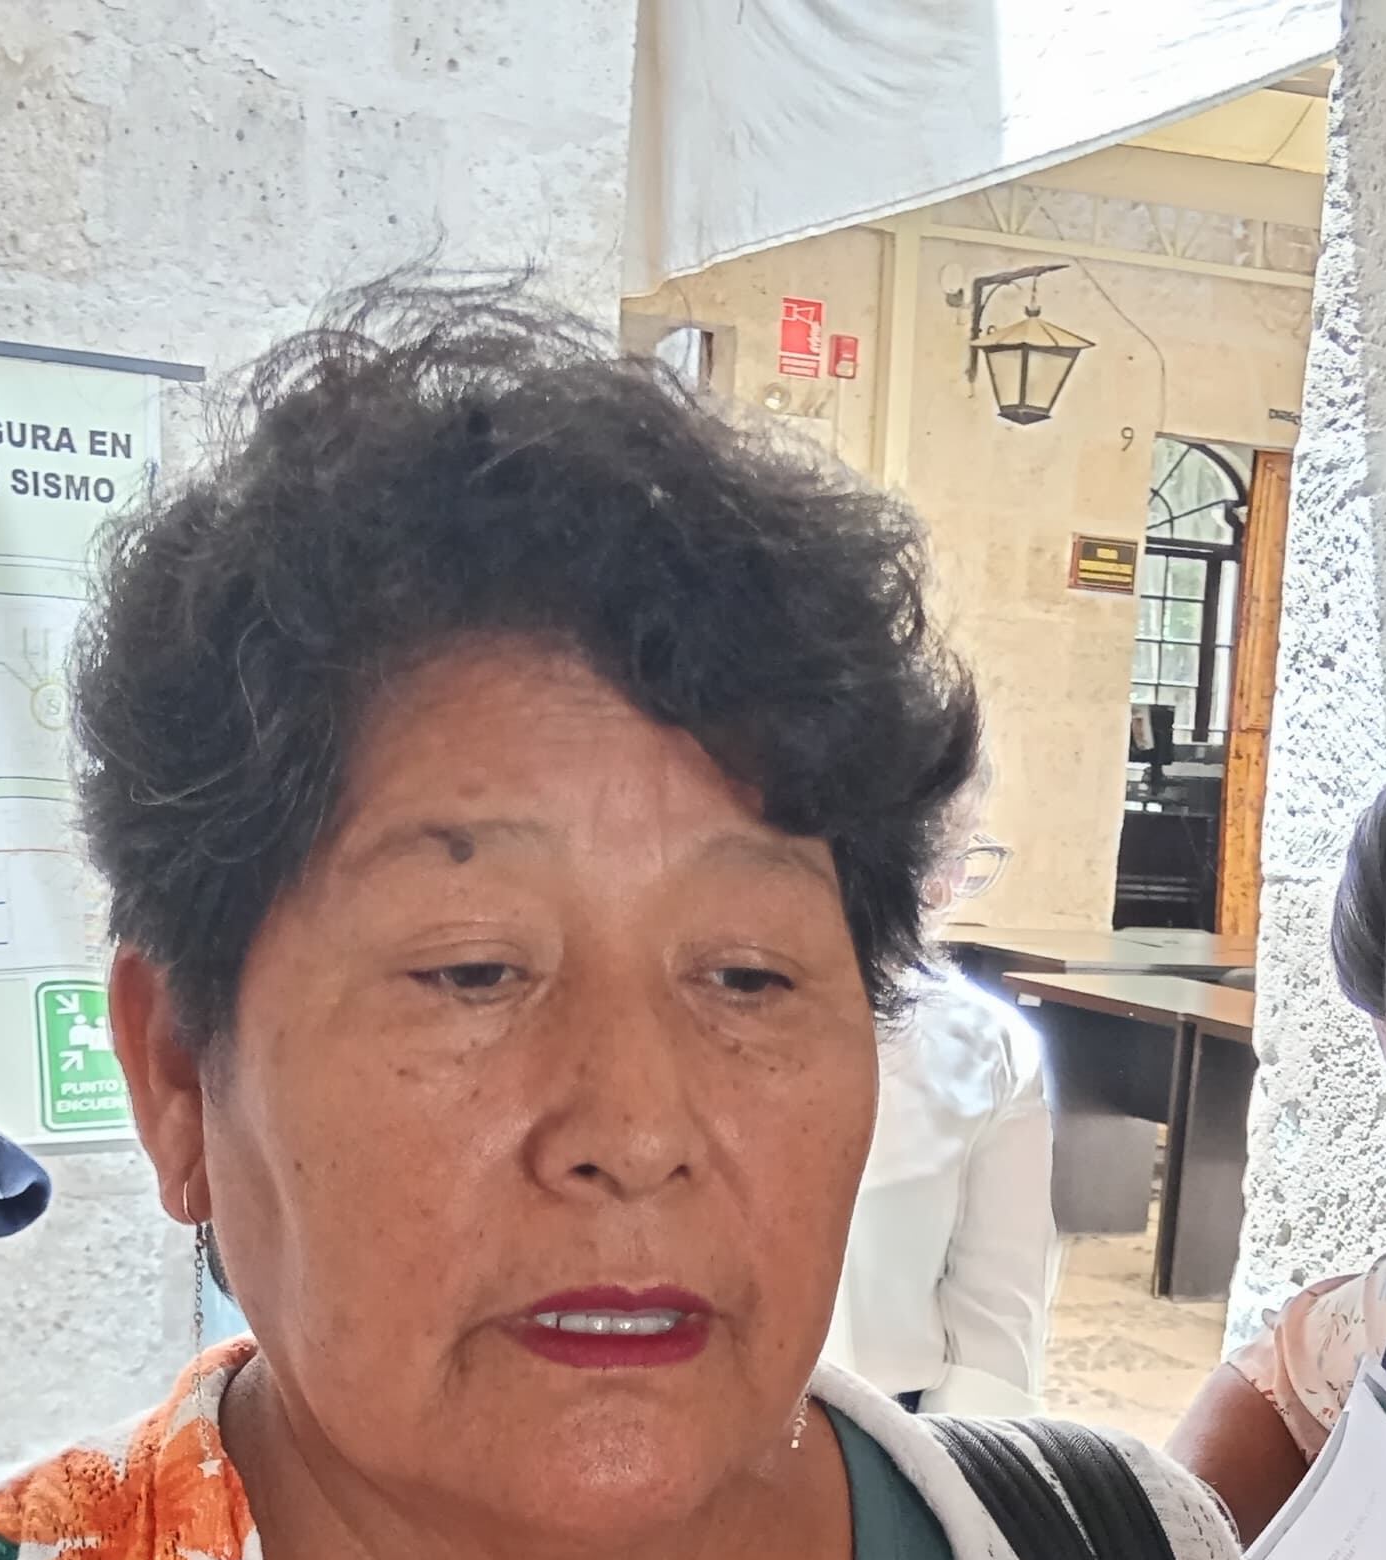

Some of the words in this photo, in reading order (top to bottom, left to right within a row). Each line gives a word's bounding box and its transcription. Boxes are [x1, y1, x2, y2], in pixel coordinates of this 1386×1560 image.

[88, 429, 133, 459] EN
[1120, 426, 1135, 452] 9
[10, 469, 116, 504] SISMO
[60, 1079, 120, 1096] PUNTO
